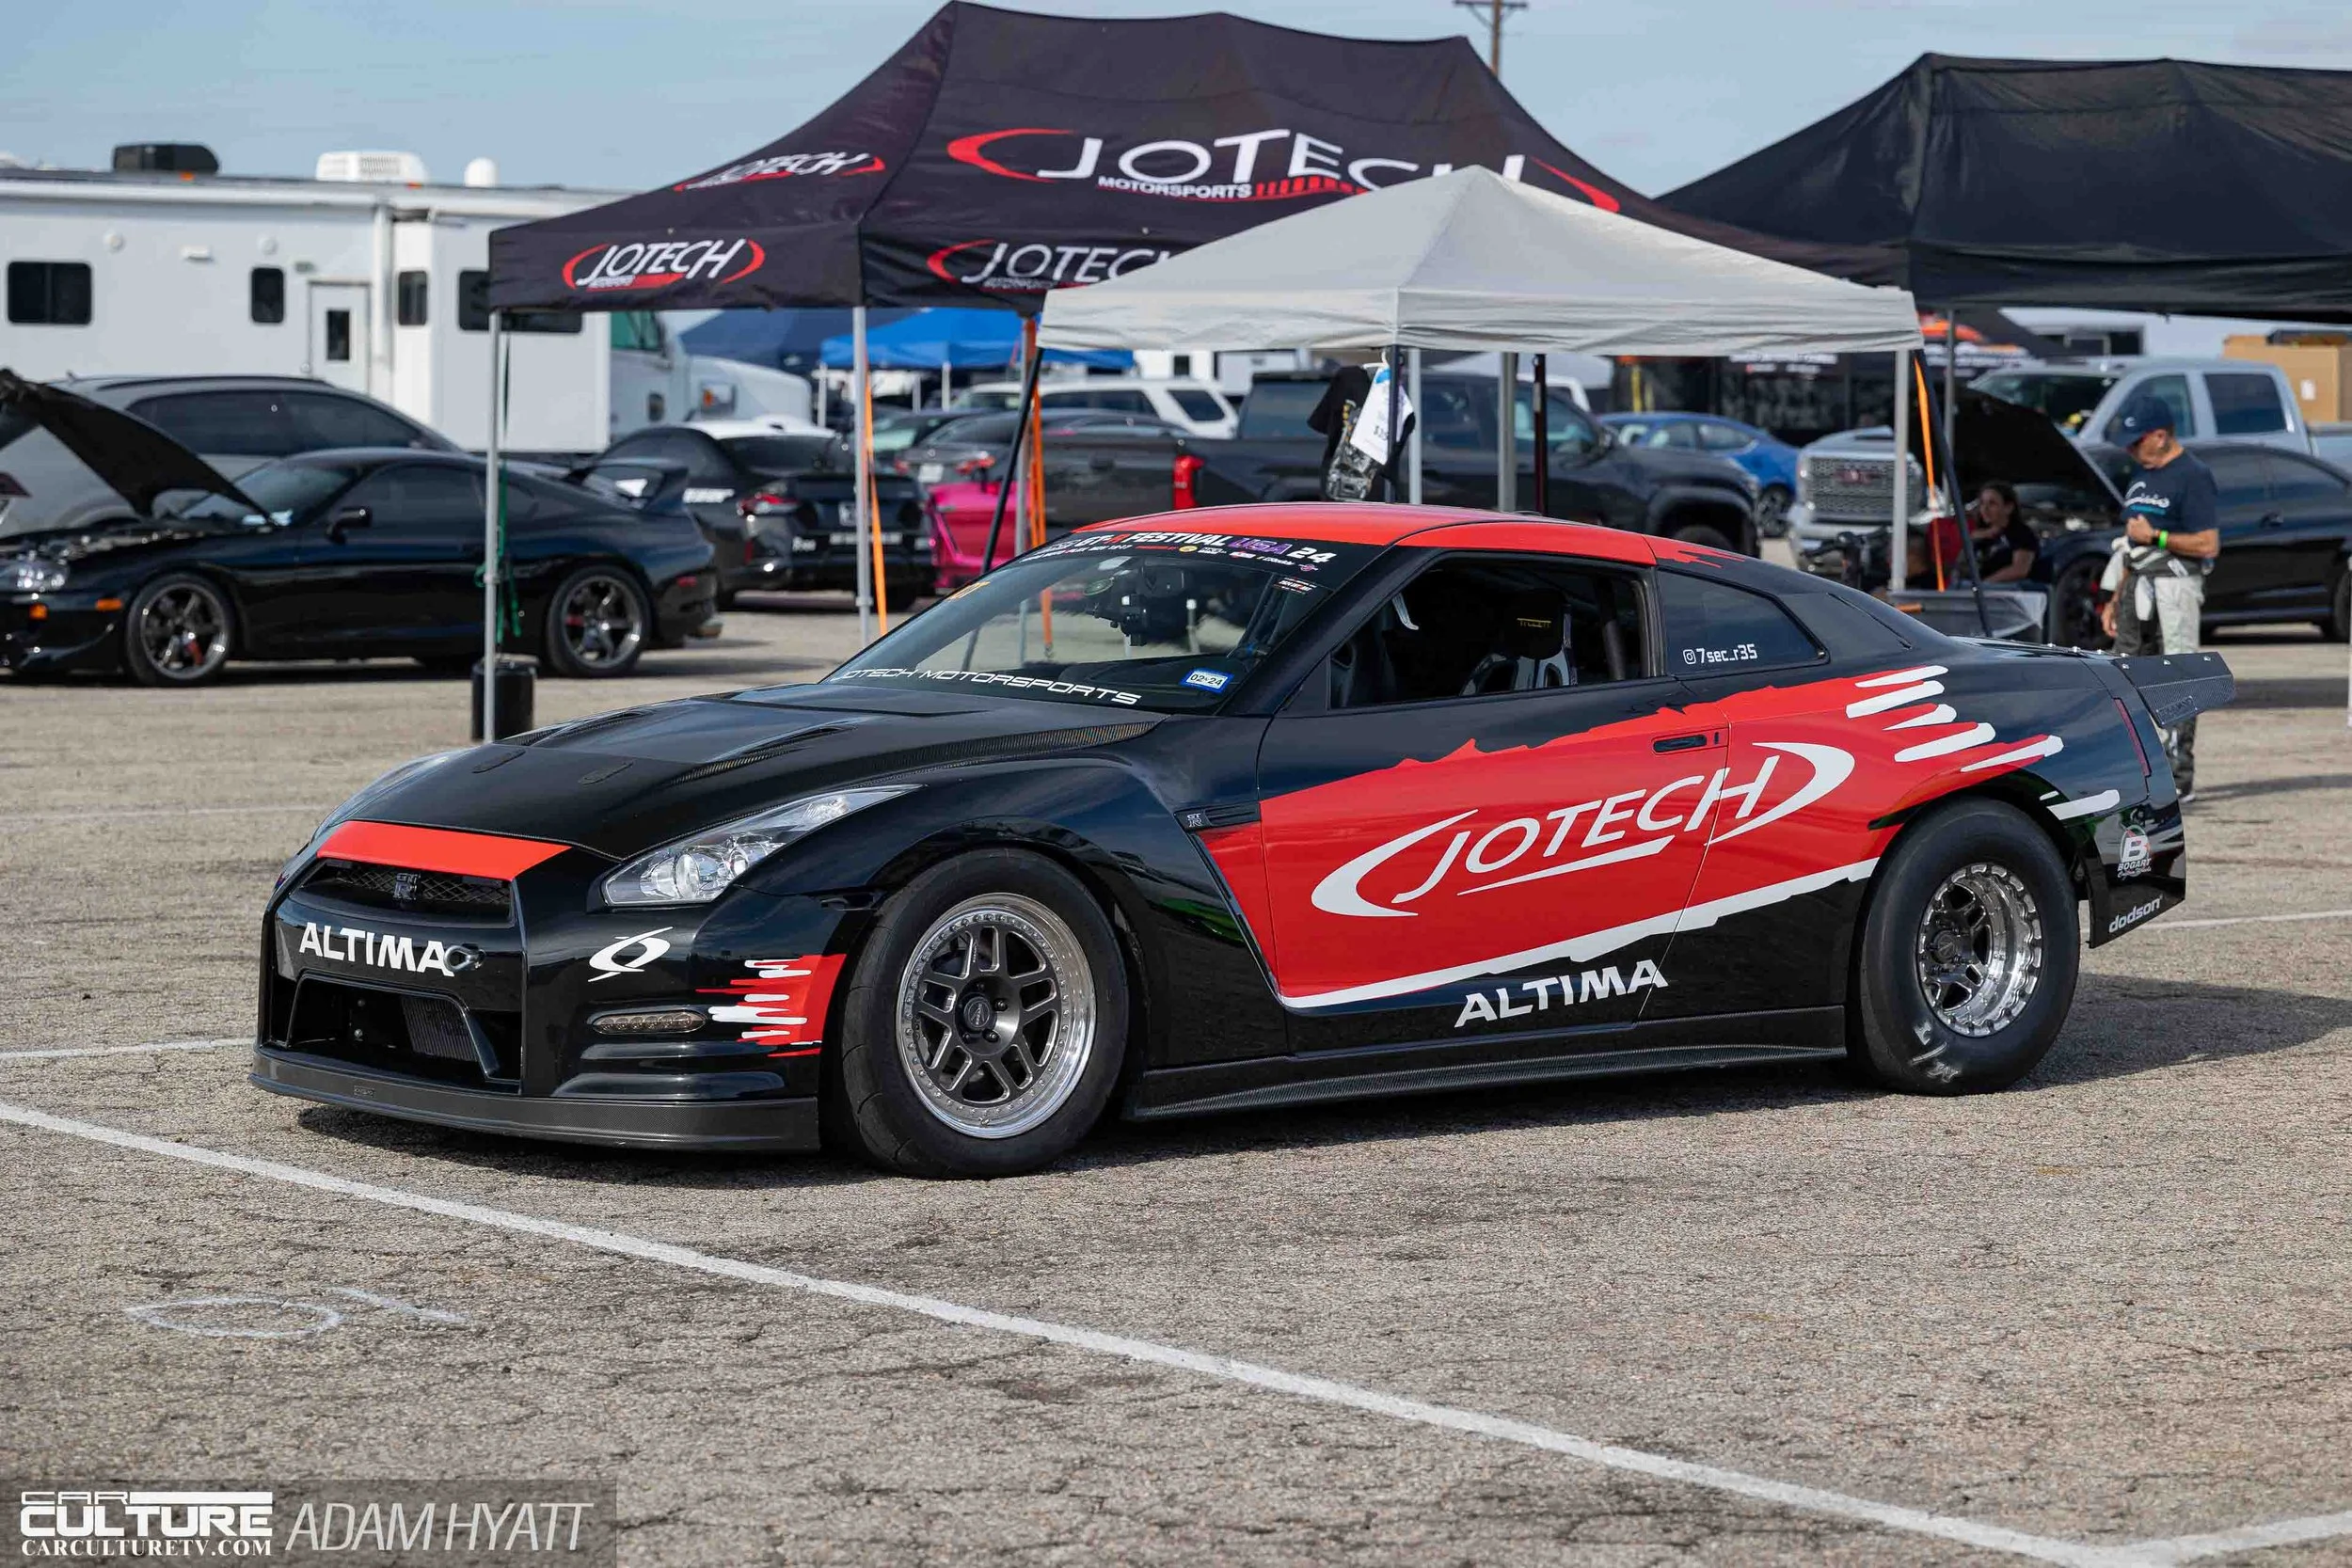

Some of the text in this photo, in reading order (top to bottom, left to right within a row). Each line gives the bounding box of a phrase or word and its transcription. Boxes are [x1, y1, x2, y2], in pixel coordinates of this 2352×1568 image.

[1097, 175, 1253, 199] MOTORSPORTS
[575, 238, 746, 287] JOTECH
[961, 242, 1170, 283] JOTEC
[1120, 531, 1233, 547] FESTIVAL
[1228, 537, 1293, 555] USA
[1286, 547, 1337, 563] 24
[918, 670, 1142, 705] MOTORSPORTS
[1391, 754, 1780, 904] JOTECH
[2117, 858, 2153, 872] BOGART
[2108, 896, 2162, 934] dodson
[297, 922, 455, 977] ALTIMA
[1454, 958, 1669, 1028] ALTIMA
